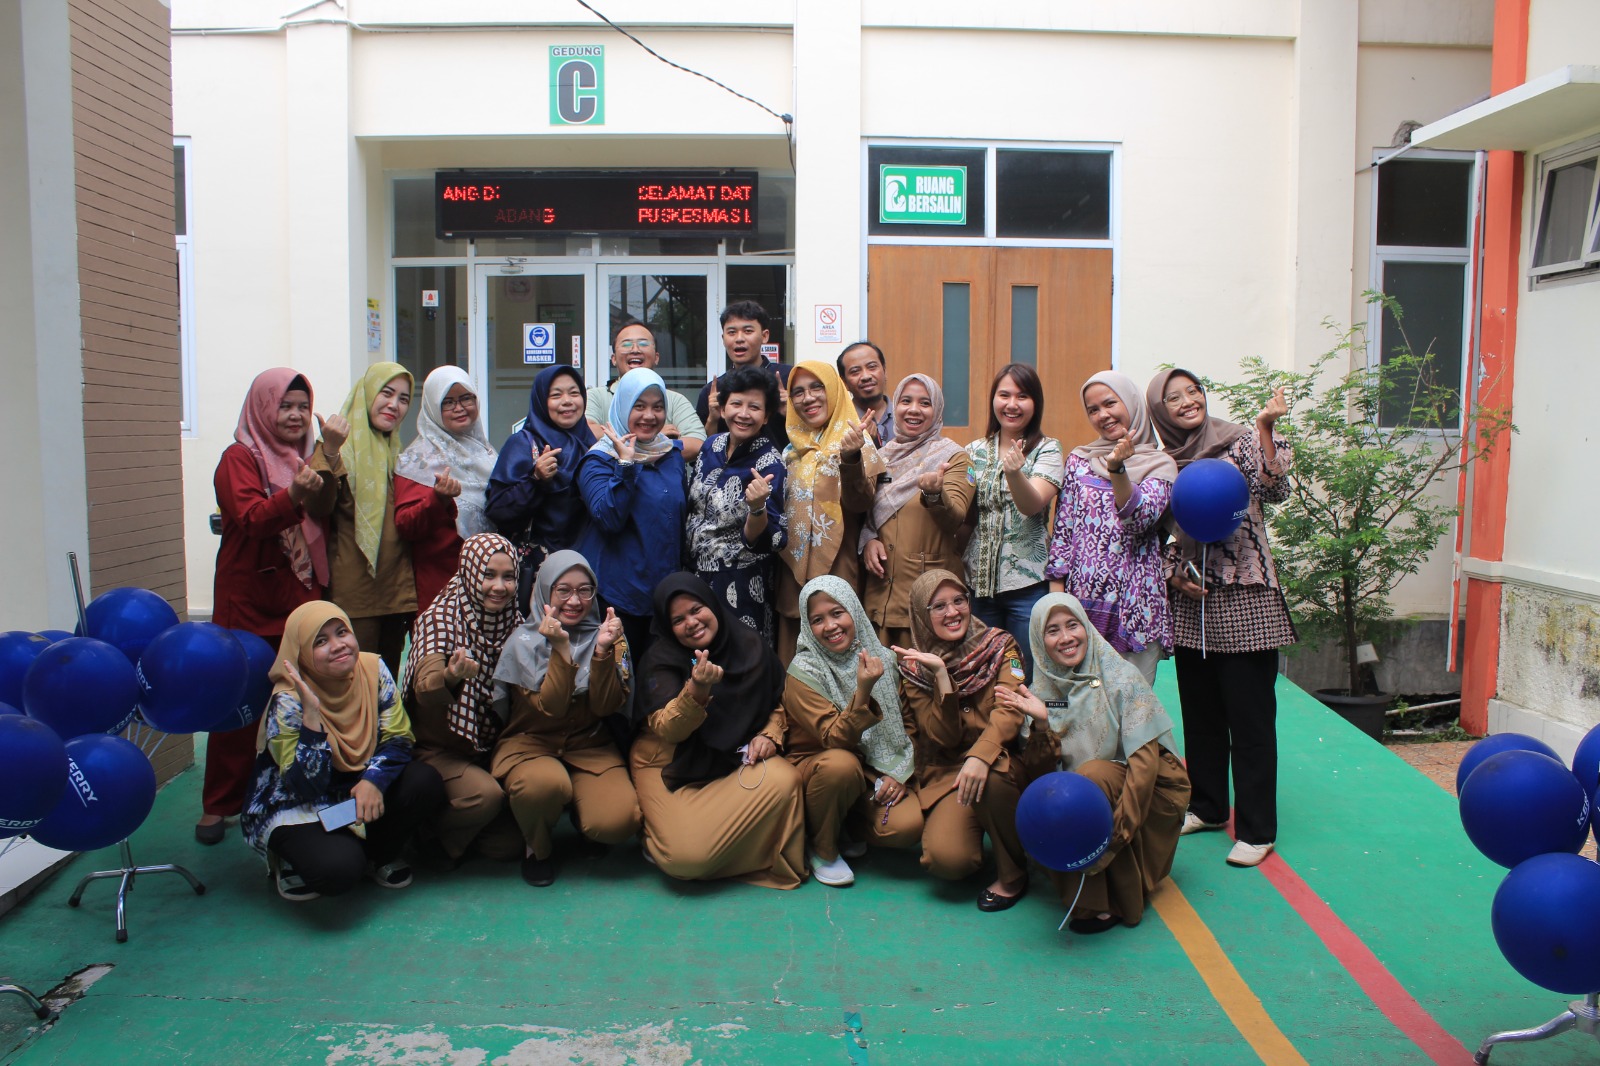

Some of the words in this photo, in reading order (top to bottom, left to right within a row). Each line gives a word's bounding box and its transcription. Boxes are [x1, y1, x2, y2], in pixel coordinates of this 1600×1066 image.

[552, 46, 601, 56] GEDUNG
[557, 59, 597, 124] C
[443, 186, 480, 200] ANG
[915, 176, 955, 194] RUANG
[908, 195, 962, 213] BERSALIN
[638, 208, 740, 223] PUSKESMAS
[68, 756, 98, 801] ERRY
[0, 818, 44, 827] ERRY
